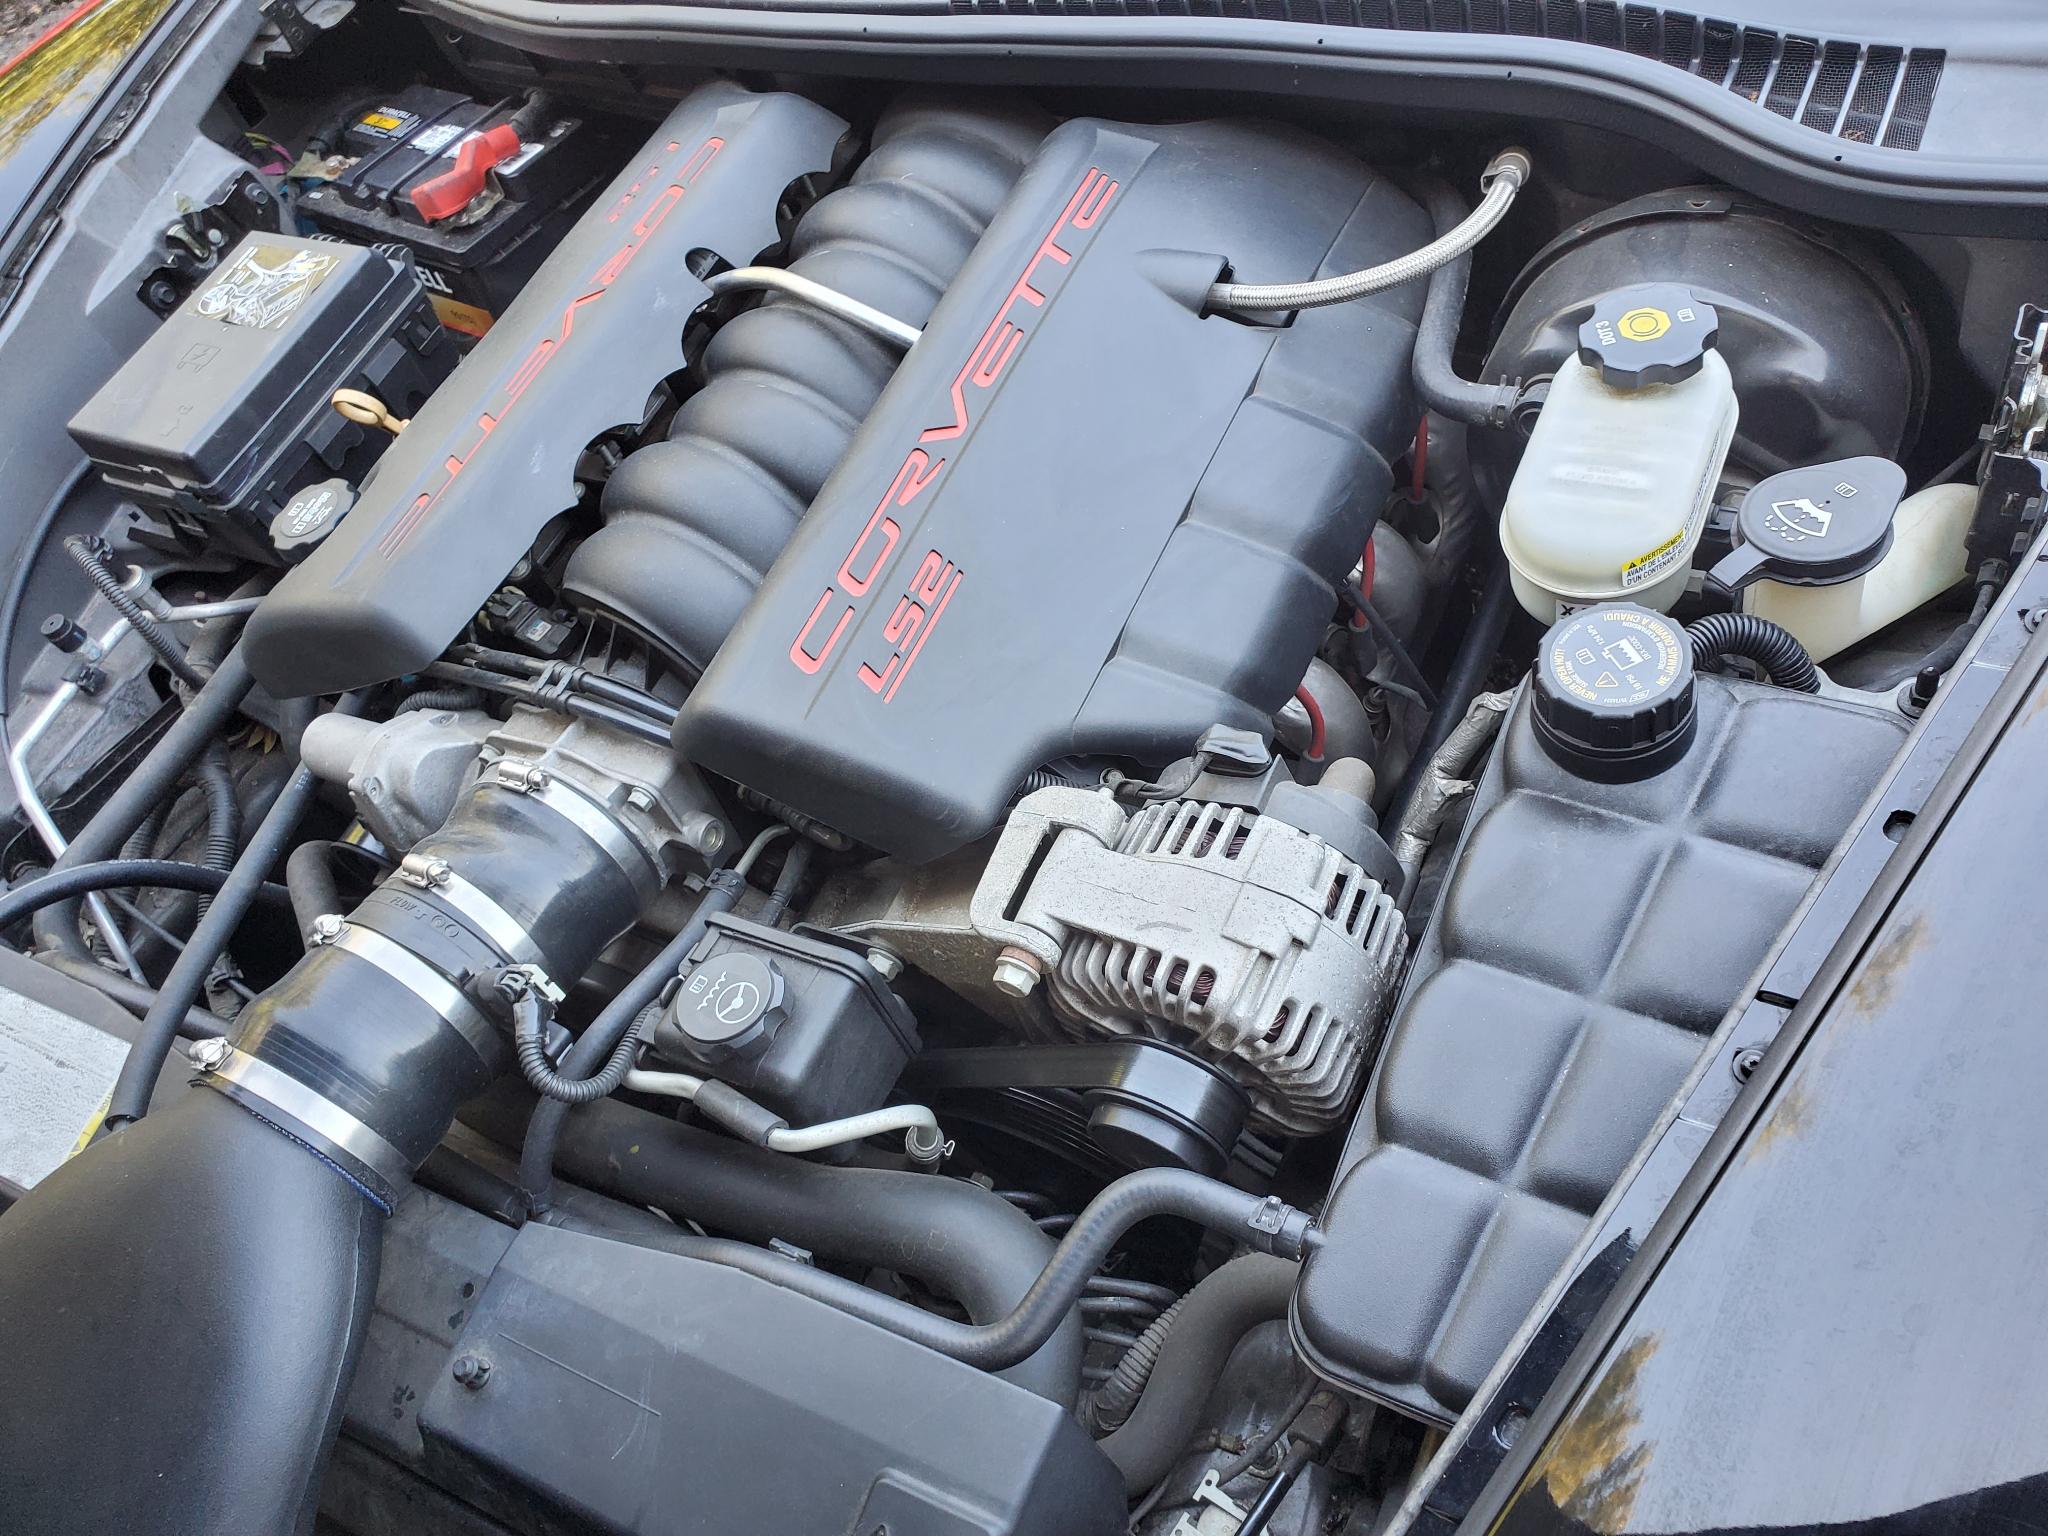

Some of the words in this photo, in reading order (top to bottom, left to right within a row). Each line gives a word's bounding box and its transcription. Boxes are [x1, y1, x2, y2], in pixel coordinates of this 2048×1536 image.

[379, 136, 724, 561] CORVETTE
[788, 165, 1121, 677] CORVETTE
[1626, 563, 1647, 578] AVANT
[1647, 557, 1657, 568] DE
[856, 548, 956, 696] LS2
[1649, 621, 1674, 646] OUVRIR
[1553, 648, 1566, 662] HOT!
[1663, 646, 1679, 676] JAMAIS
[1554, 662, 1574, 685] OPEN
[1656, 674, 1670, 687] NE
[1568, 682, 1598, 701] NEVER
